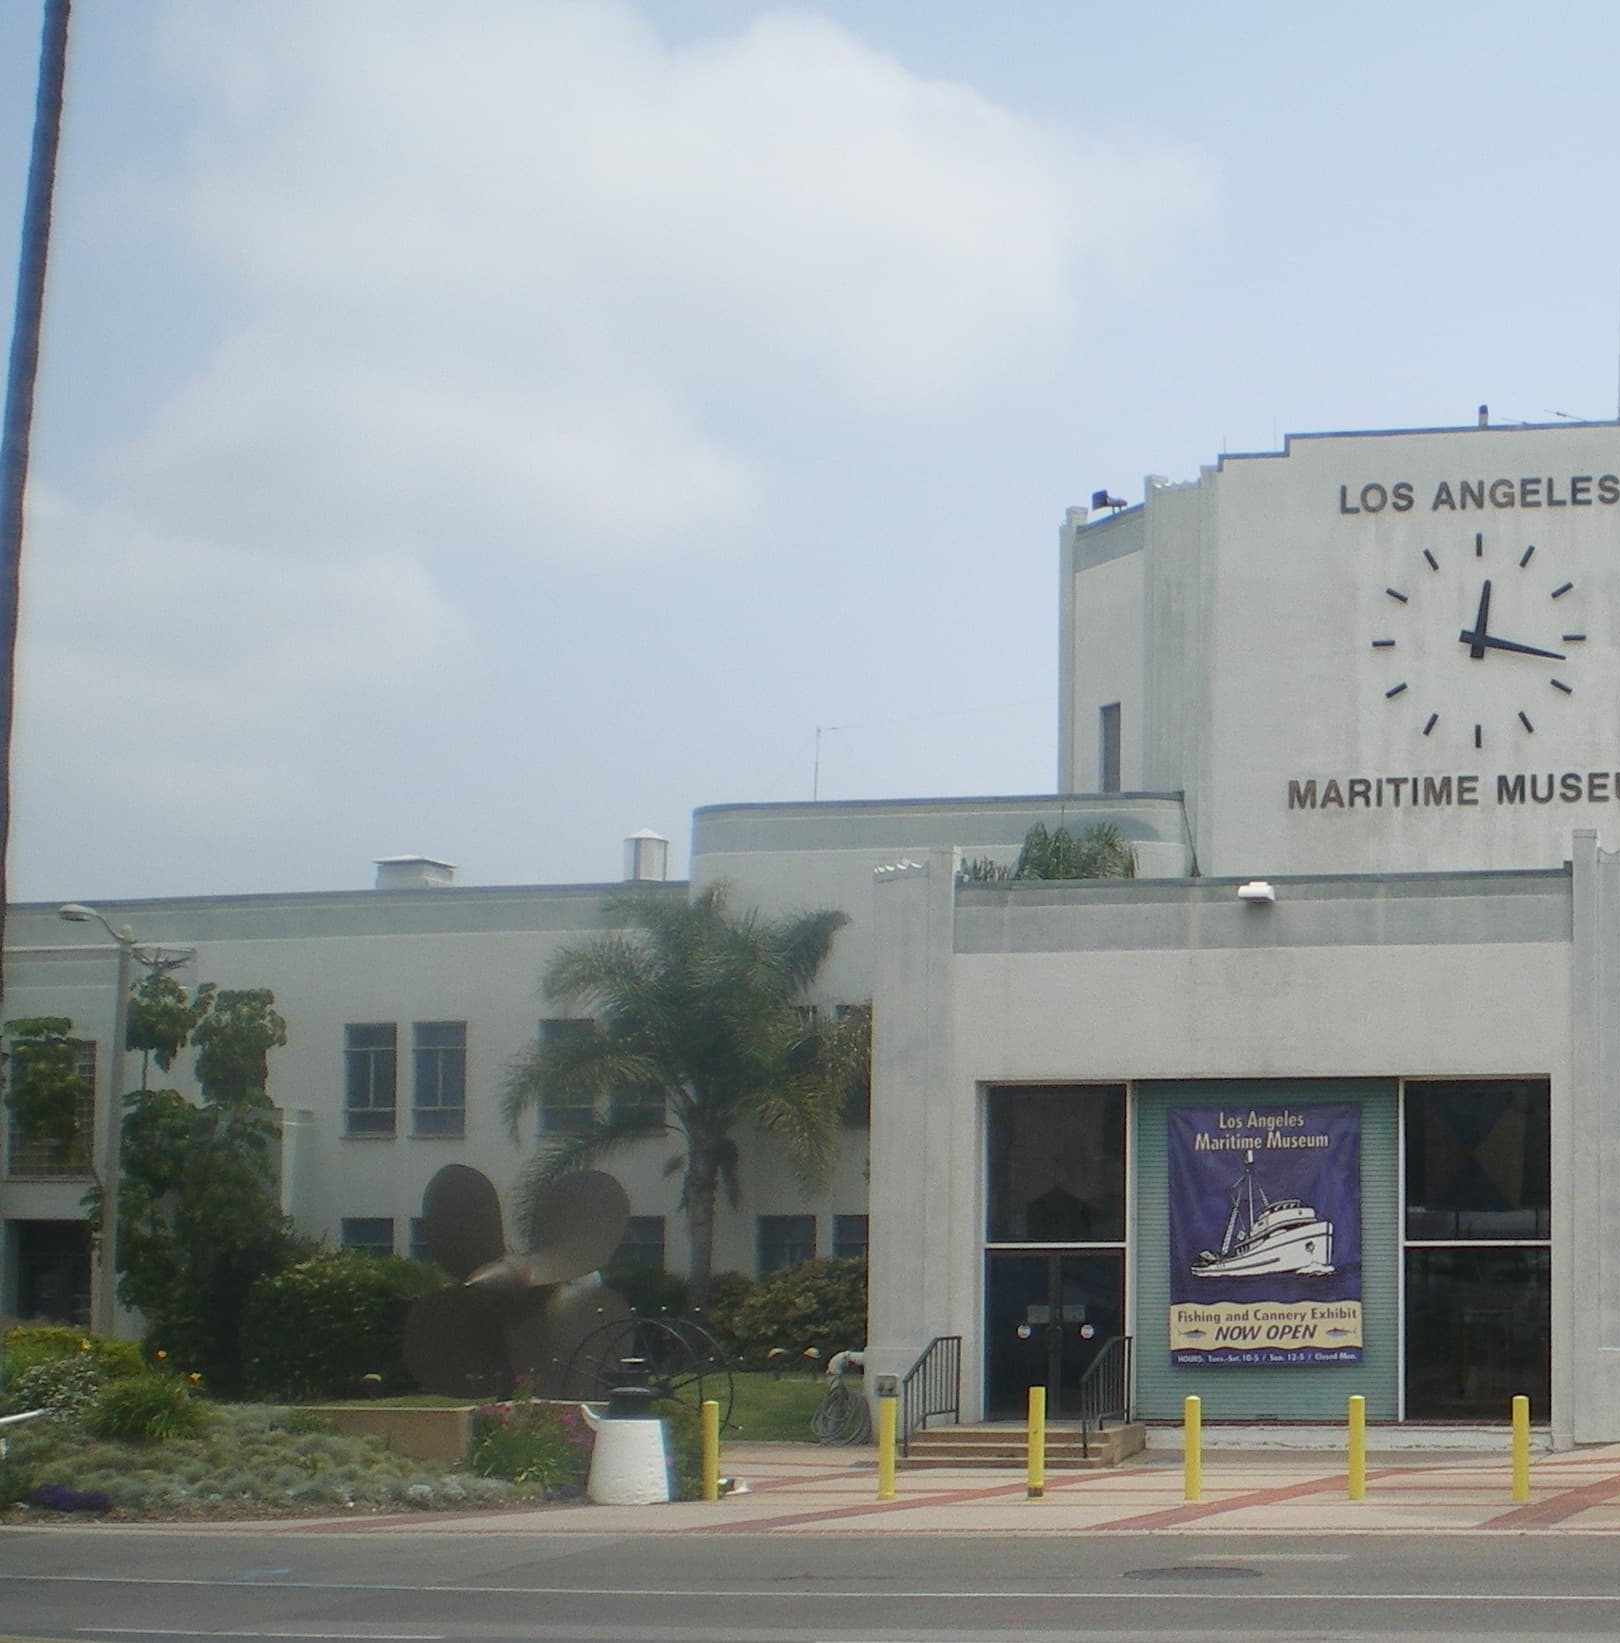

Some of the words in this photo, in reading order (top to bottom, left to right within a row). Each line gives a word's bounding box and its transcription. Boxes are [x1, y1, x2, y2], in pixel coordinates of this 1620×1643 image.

[1340, 481, 1415, 514] LOS
[1432, 474, 1620, 511] ANGELES
[1288, 775, 1480, 809] MARITIME
[1219, 1111, 1243, 1129] Los
[1247, 1110, 1305, 1131] Angeles
[1195, 1132, 1262, 1150] Maritime
[1267, 1130, 1329, 1149] Museum
[1178, 1310, 1221, 1324] Fishing
[1225, 1310, 1249, 1322] and
[1253, 1309, 1307, 1323] Cannery
[1311, 1308, 1357, 1320] Exhibit
[1215, 1326, 1262, 1341] NOW
[1265, 1324, 1318, 1340] OPEN
